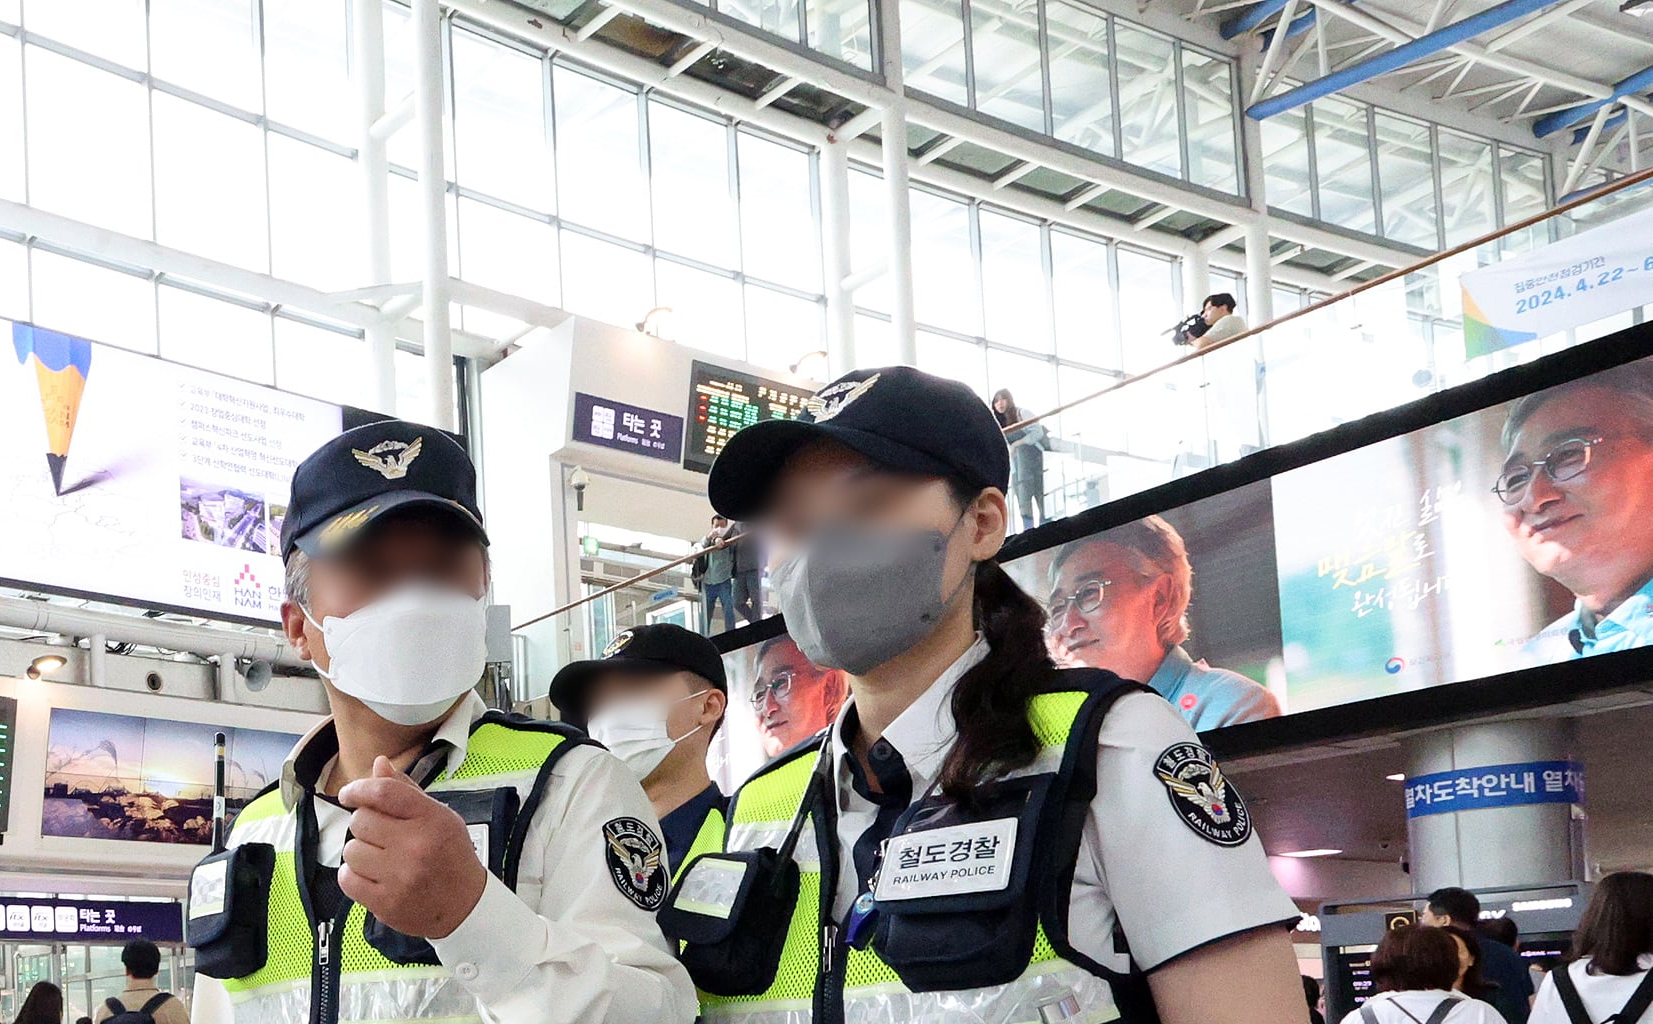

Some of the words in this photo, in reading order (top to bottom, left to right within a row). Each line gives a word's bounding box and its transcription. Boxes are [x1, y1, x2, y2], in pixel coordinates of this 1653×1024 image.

[623, 412, 645, 434] 타는
[650, 419, 661, 438] 곳
[183, 569, 220, 588] 인성중심
[184, 585, 221, 602] 창의인재
[235, 588, 261, 599] HAN
[235, 598, 261, 609] NAM
[1188, 812, 1232, 838] RAILWAY
[1233, 802, 1246, 836] POLICE
[899, 835, 1000, 870] 철도경찰
[893, 870, 948, 885] RAILWAY
[950, 865, 995, 879] POLICE
[80, 908, 101, 923] 타는
[105, 909, 116, 924] 곳
